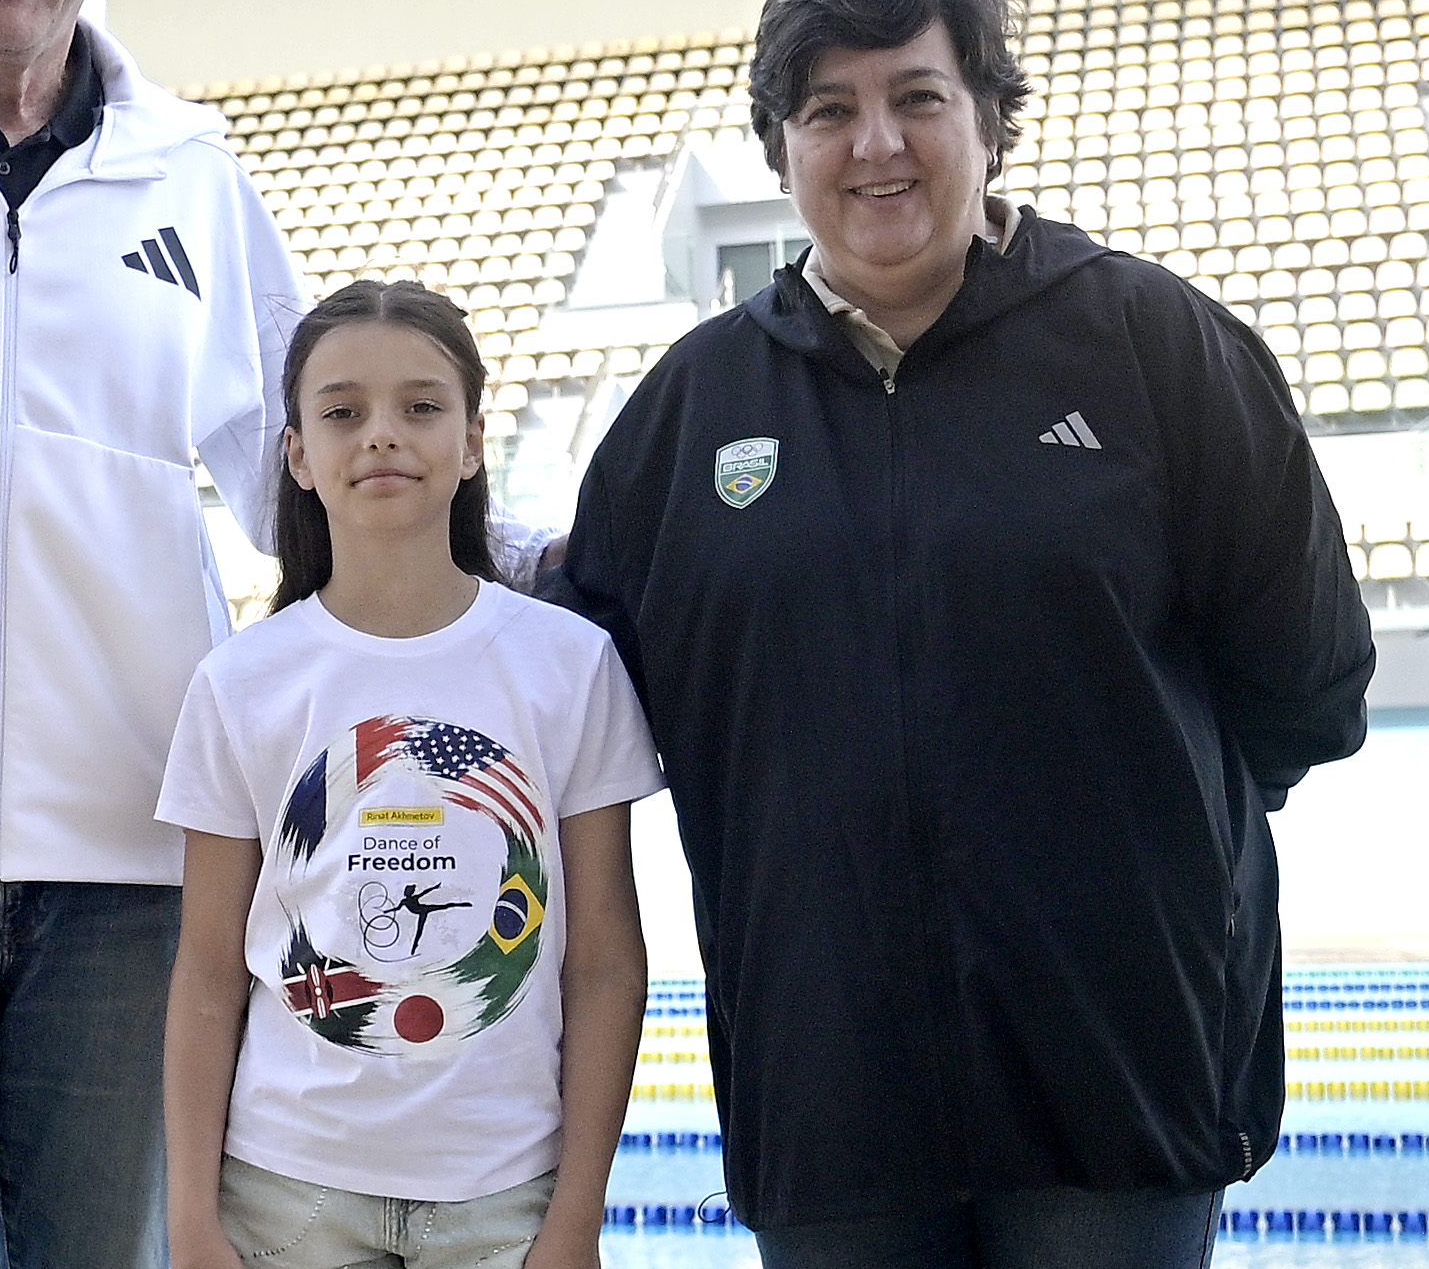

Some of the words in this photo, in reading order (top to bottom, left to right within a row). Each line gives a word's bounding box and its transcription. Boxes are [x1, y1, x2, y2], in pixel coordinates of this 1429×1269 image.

[722, 457, 769, 473] BRASIL
[366, 811, 389, 821] Rinat
[390, 811, 436, 821] Akhmetov
[363, 836, 418, 850] Dance
[423, 834, 442, 850] of
[348, 852, 456, 871] Freedom
